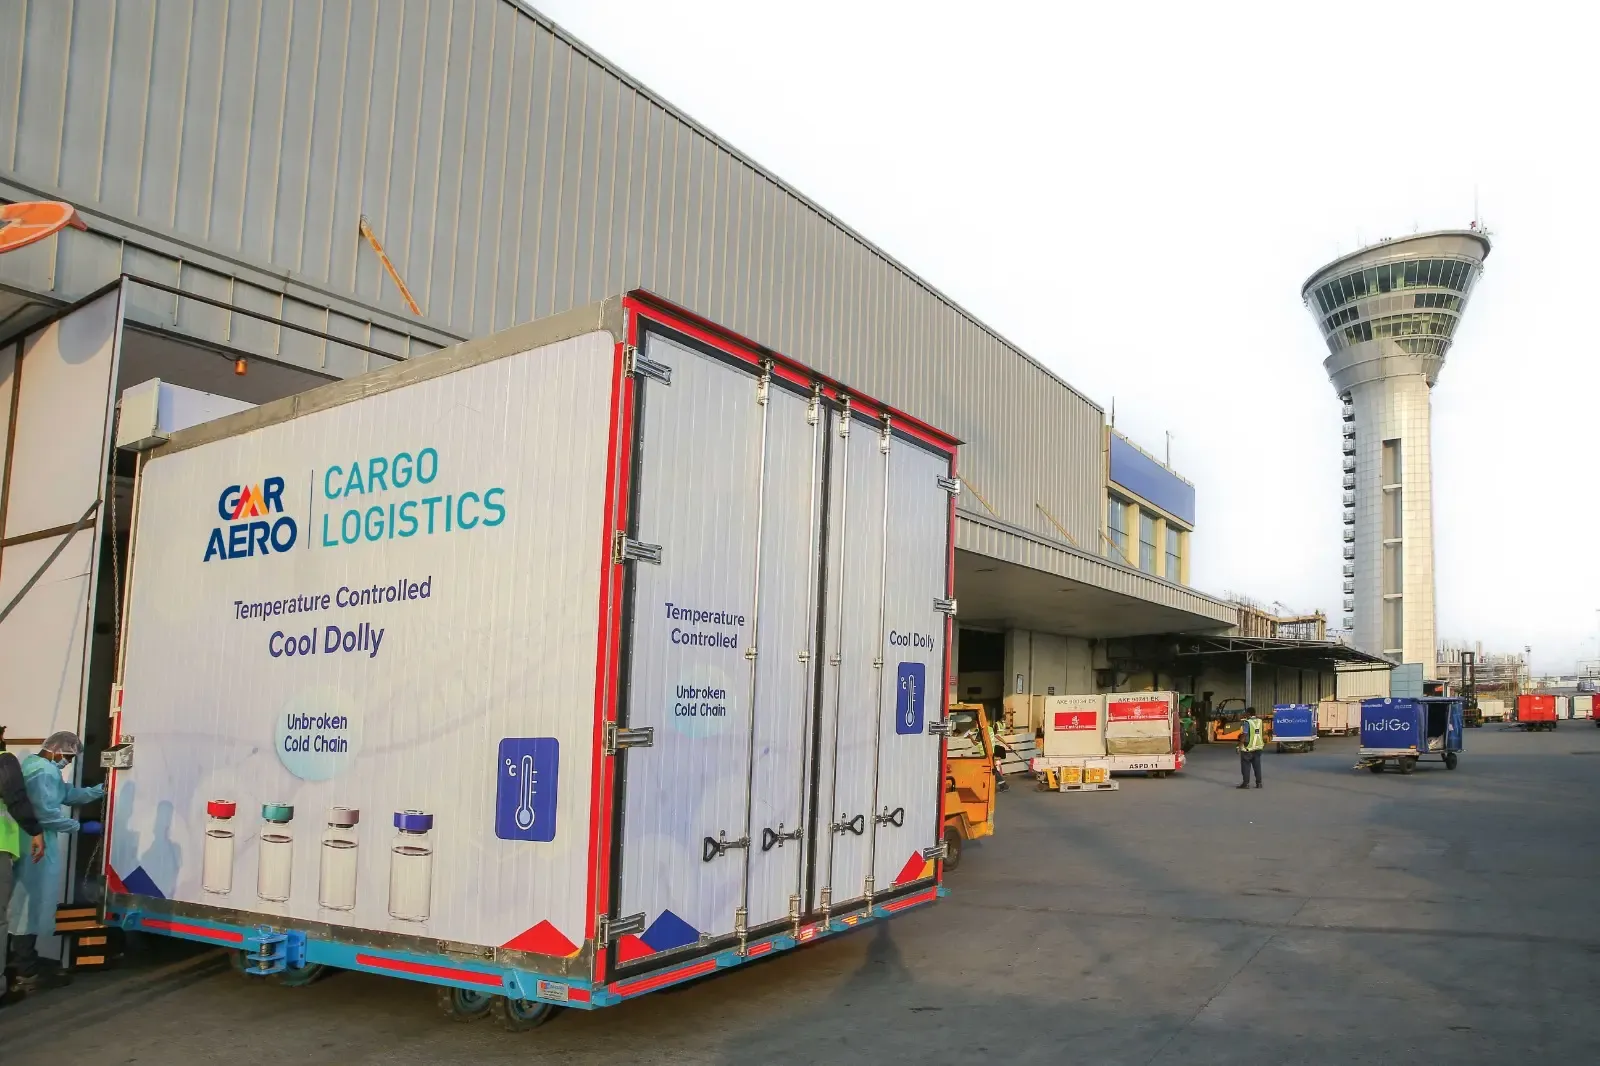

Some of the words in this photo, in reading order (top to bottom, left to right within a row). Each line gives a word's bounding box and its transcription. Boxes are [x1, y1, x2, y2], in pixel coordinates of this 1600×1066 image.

[324, 447, 438, 500] CARGO
[218, 476, 285, 521] GMR
[322, 487, 506, 548] LOGISTICS
[203, 516, 297, 562] AERO
[234, 592, 331, 621] Temperature
[335, 575, 432, 608] Controlled
[665, 602, 745, 627] Temperature
[269, 627, 317, 658] Cool
[324, 622, 385, 658] Dolly
[671, 627, 738, 649] Controlled
[889, 630, 911, 647] Cool
[913, 632, 935, 653] Dolly
[676, 684, 726, 700] Unbroken
[287, 712, 348, 730] Unbroken
[674, 702, 697, 717] Cold
[700, 702, 726, 717] Chain
[1364, 718, 1410, 731] IndiGo
[284, 734, 310, 753] Cold
[314, 734, 348, 753] Chain
